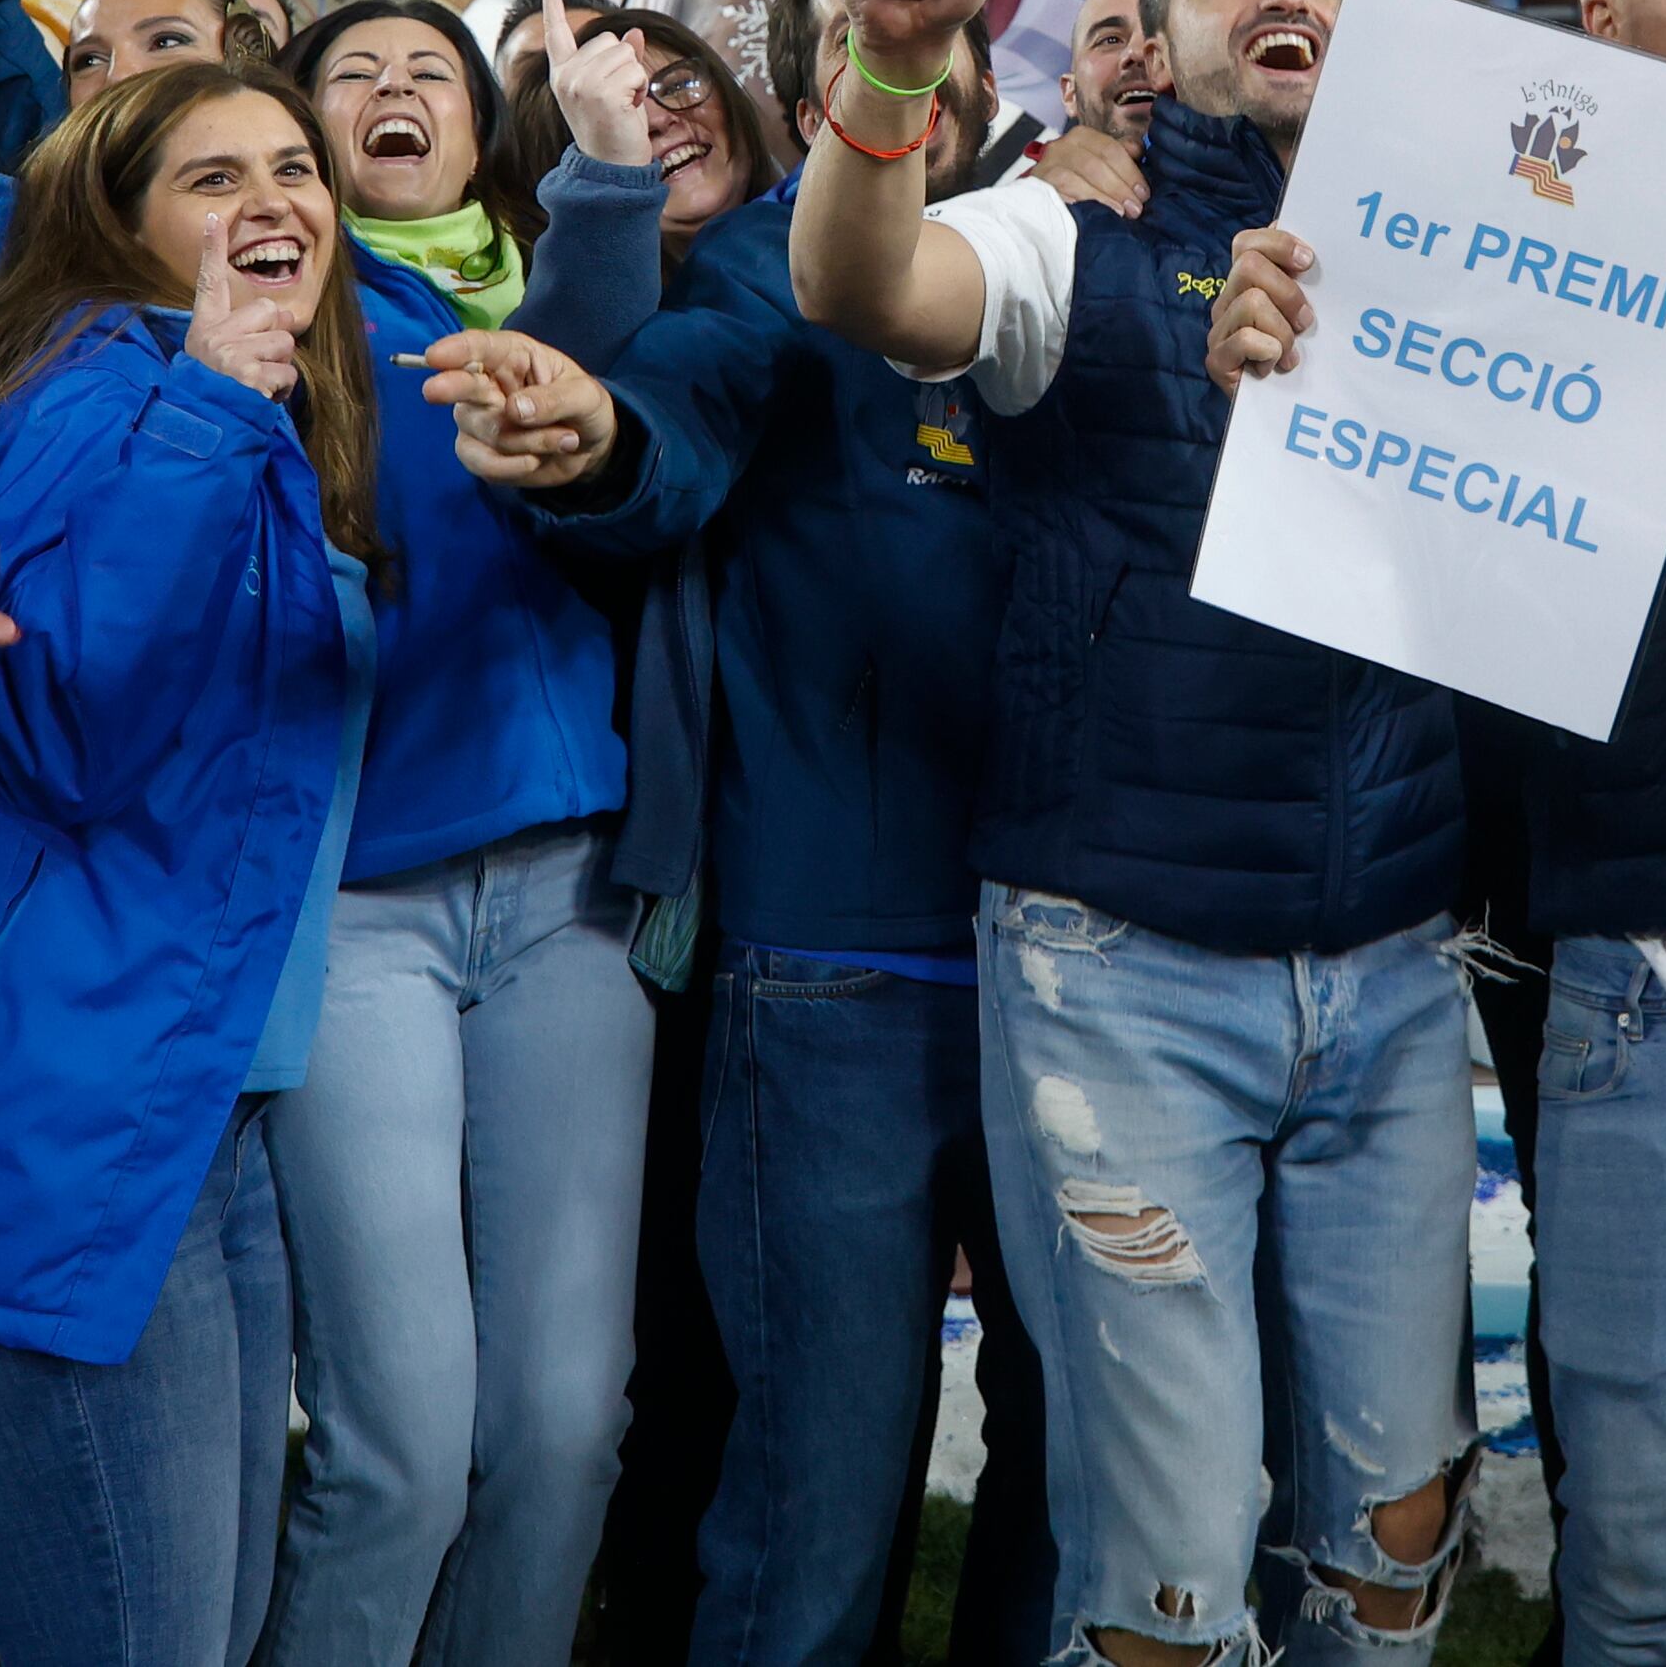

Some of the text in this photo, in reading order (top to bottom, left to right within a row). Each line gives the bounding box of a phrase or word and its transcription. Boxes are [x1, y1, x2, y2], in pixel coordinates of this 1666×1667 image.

[1520, 78, 1599, 117] L'Antiga
[1355, 190, 1451, 258] 1er
[1352, 306, 1603, 425] SECCIÓ
[1285, 403, 1599, 554] ESPECIAL
